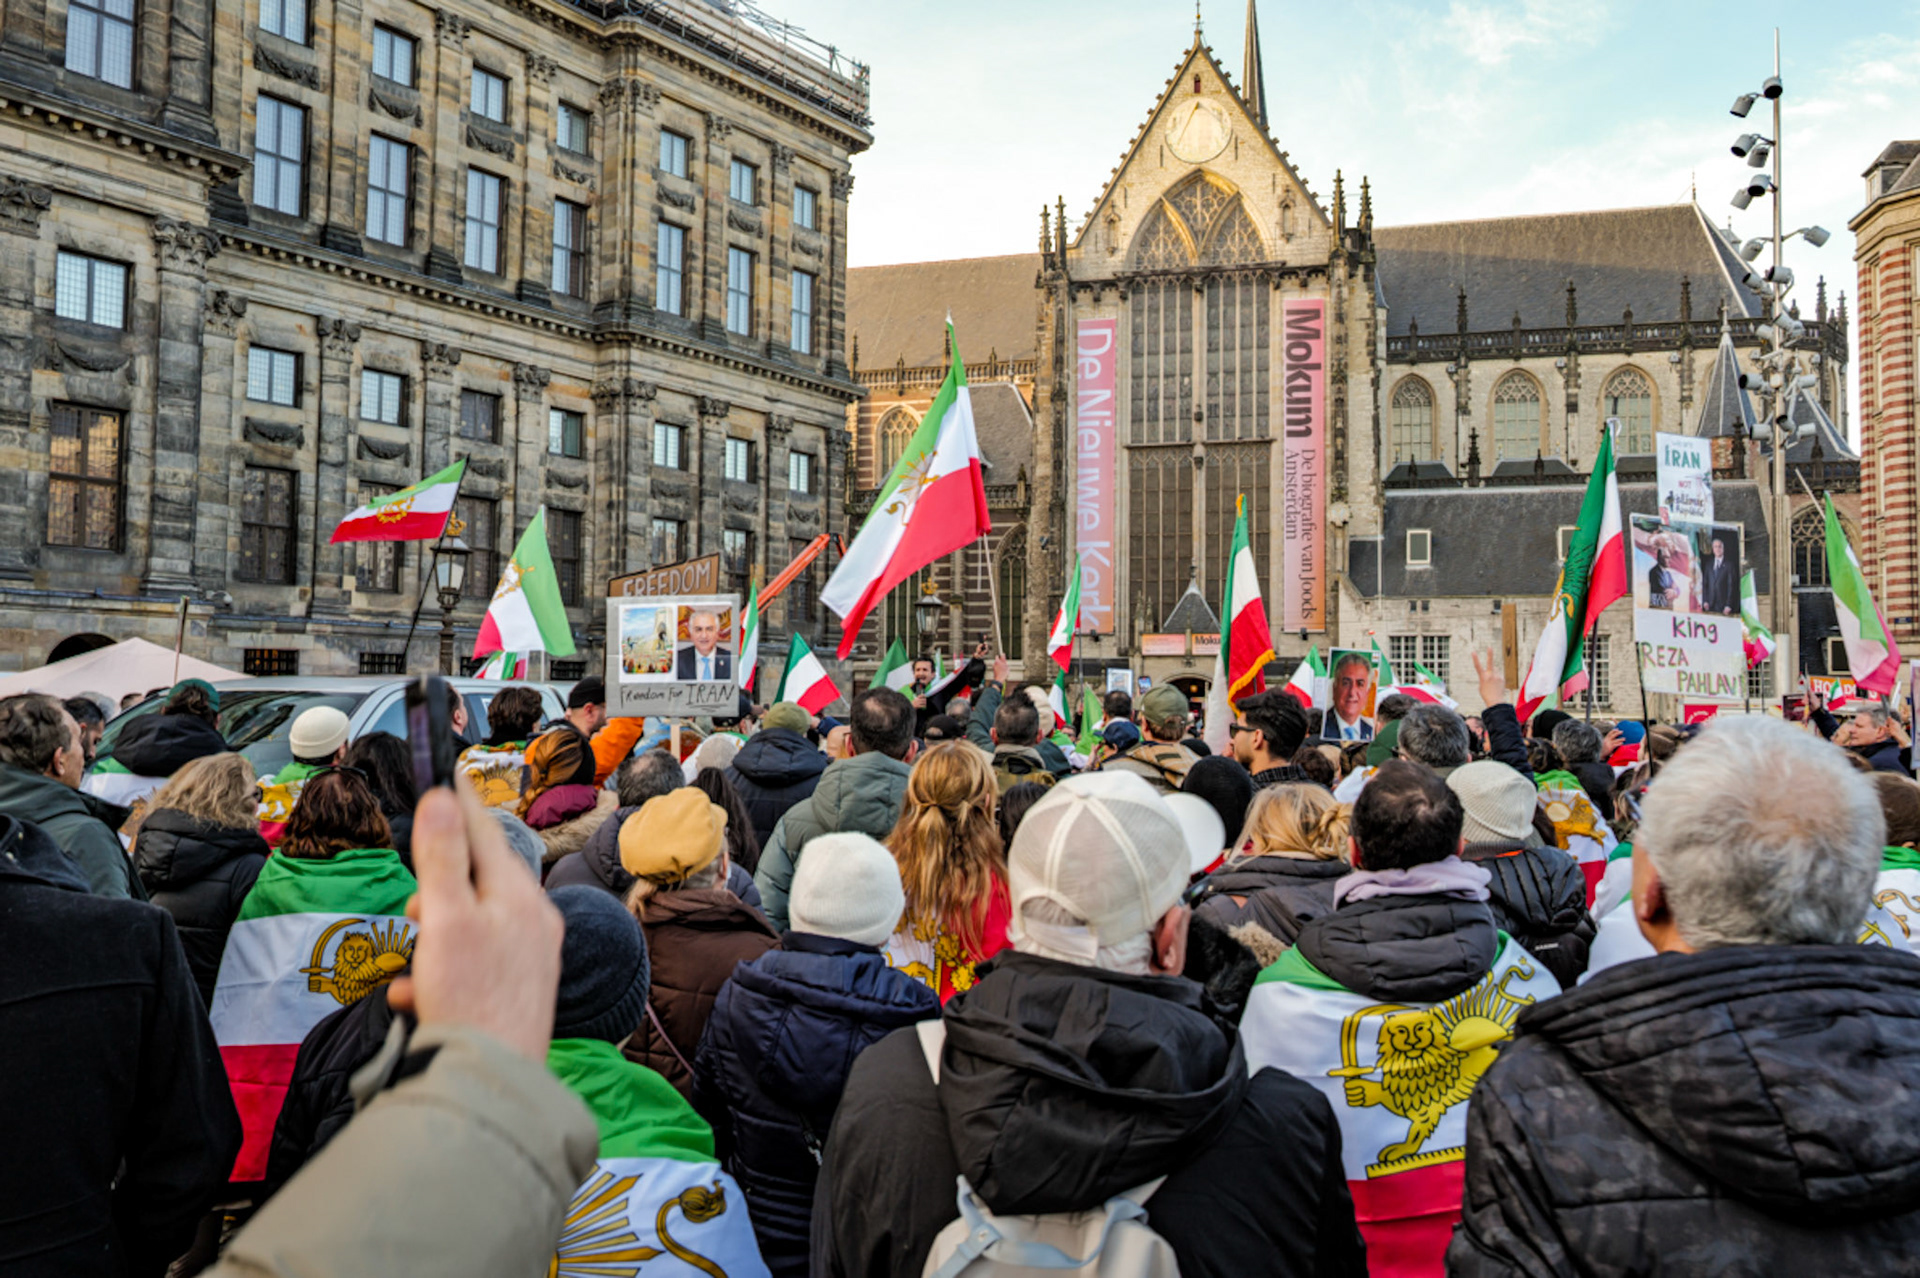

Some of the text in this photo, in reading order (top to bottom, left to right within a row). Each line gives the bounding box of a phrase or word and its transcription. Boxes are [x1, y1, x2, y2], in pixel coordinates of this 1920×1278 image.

[1285, 308, 1322, 438] Mokum
[1077, 328, 1112, 627] De Nieuwe Kerk
[1285, 449, 1301, 540] Amsterdam
[1299, 449, 1317, 620] De biografie van Joods
[622, 560, 712, 597] FREEDOM
[1195, 635, 1221, 645] Moku
[1638, 641, 1690, 668] REZA
[686, 684, 734, 705] IRAN
